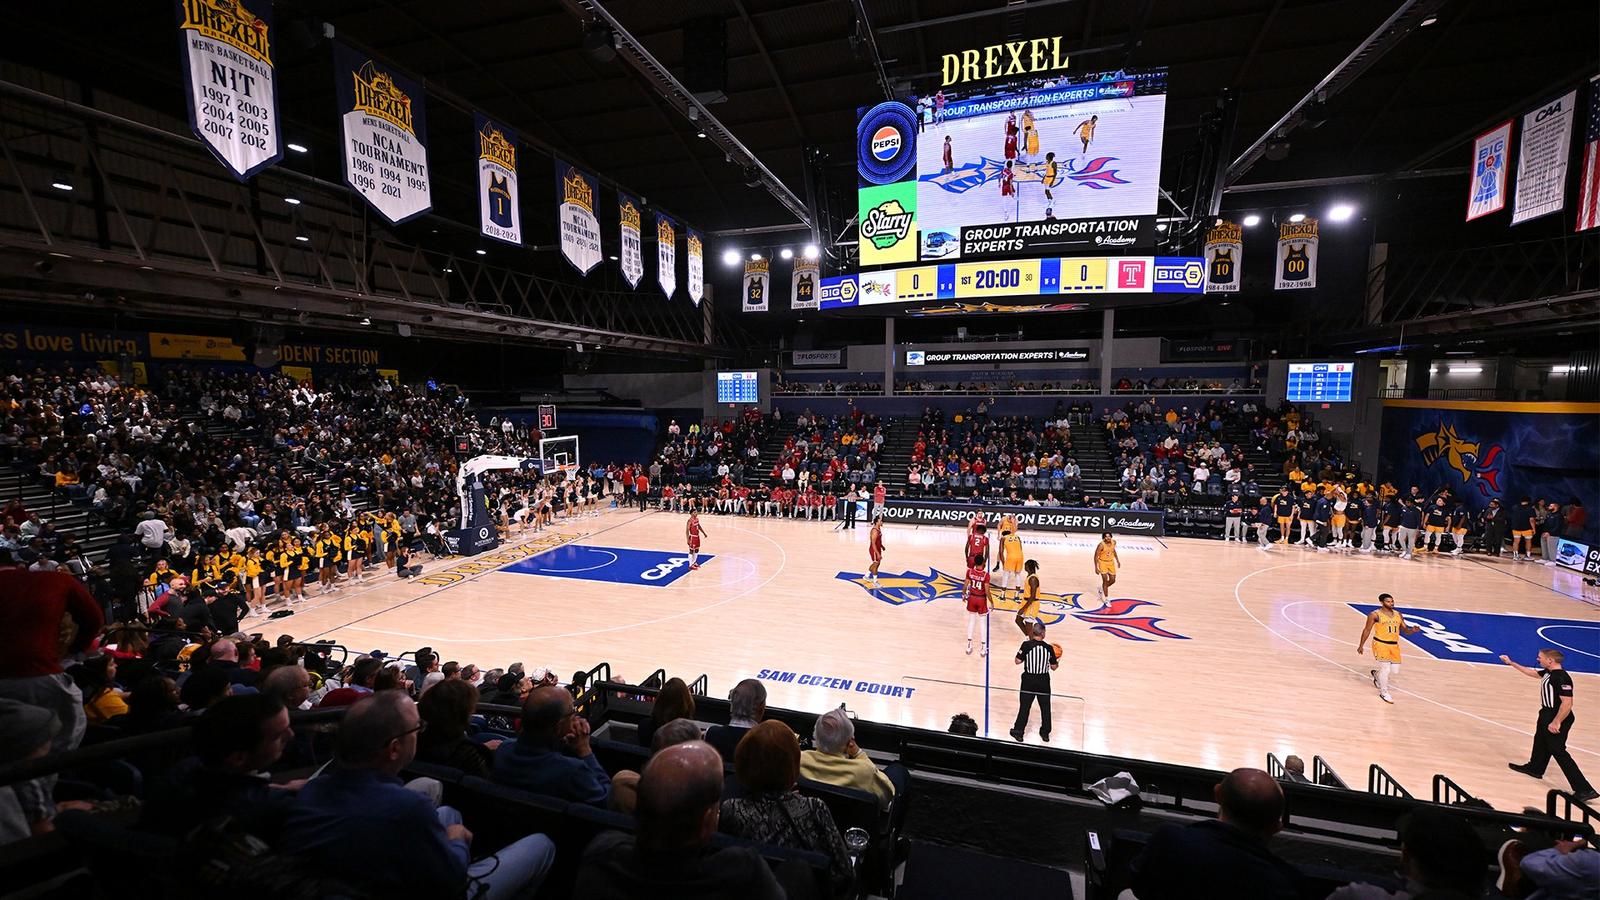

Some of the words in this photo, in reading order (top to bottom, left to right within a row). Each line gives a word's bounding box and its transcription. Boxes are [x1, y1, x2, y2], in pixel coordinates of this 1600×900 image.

[217, 46, 270, 81] BASKETBALL
[942, 36, 1069, 87] DREXEL
[210, 60, 255, 98] NIT
[202, 85, 231, 107] 1997
[237, 99, 268, 120] 2003
[968, 92, 1051, 113] TRANSPORTATION
[1052, 88, 1095, 103] EXPERTS
[202, 101, 235, 124] 2004
[239, 116, 269, 136] 2005
[1535, 101, 1562, 123] CAA
[204, 118, 233, 140] 2007
[240, 132, 267, 151] 2012
[373, 132, 403, 156] NCAA
[873, 138, 900, 149] PEPSI
[352, 138, 425, 176] TOURNAMENT
[1479, 141, 1504, 159] BIG
[352, 157, 375, 175] 1986
[380, 166, 402, 184] 1994
[406, 176, 428, 193] 1995
[353, 173, 376, 190] 1996
[381, 182, 402, 199] 2021
[497, 197, 504, 216] 1
[485, 224, 518, 242] 2018-2023
[861, 208, 912, 239] Starry
[964, 226, 1011, 241] GROUP
[1015, 219, 1139, 238] TRANSPORTATION
[964, 239, 1023, 254] EXPERTS
[1103, 234, 1137, 246] Academy
[1081, 264, 1087, 281] 0
[1157, 271, 1180, 279] BIG
[1216, 263, 1230, 276] 10
[1288, 260, 1305, 273] 00
[913, 274, 919, 290] 0
[961, 276, 971, 285] 1ST
[975, 268, 1020, 289] 20:00
[1025, 273, 1033, 281] 30
[751, 288, 761, 299] 32
[799, 285, 812, 296] 44
[822, 288, 840, 298] BIG
[24, 328, 74, 352] love
[325, 345, 379, 365] SECTION
[926, 353, 951, 362] GROUP
[952, 352, 1018, 361] TRANSPORTATION
[1019, 350, 1053, 360] EXPERTS
[847, 397, 853, 405] 2
[542, 415, 552, 427] 30
[1037, 513, 1101, 528] EXPERTS
[1116, 515, 1155, 530] Academy
[975, 539, 981, 547] 2
[640, 557, 690, 580] CAA
[971, 579, 983, 591] 14
[1399, 613, 1494, 654] CAA
[756, 669, 797, 683] SAM
[797, 674, 853, 690] COZEN
[855, 681, 916, 698] COURT
